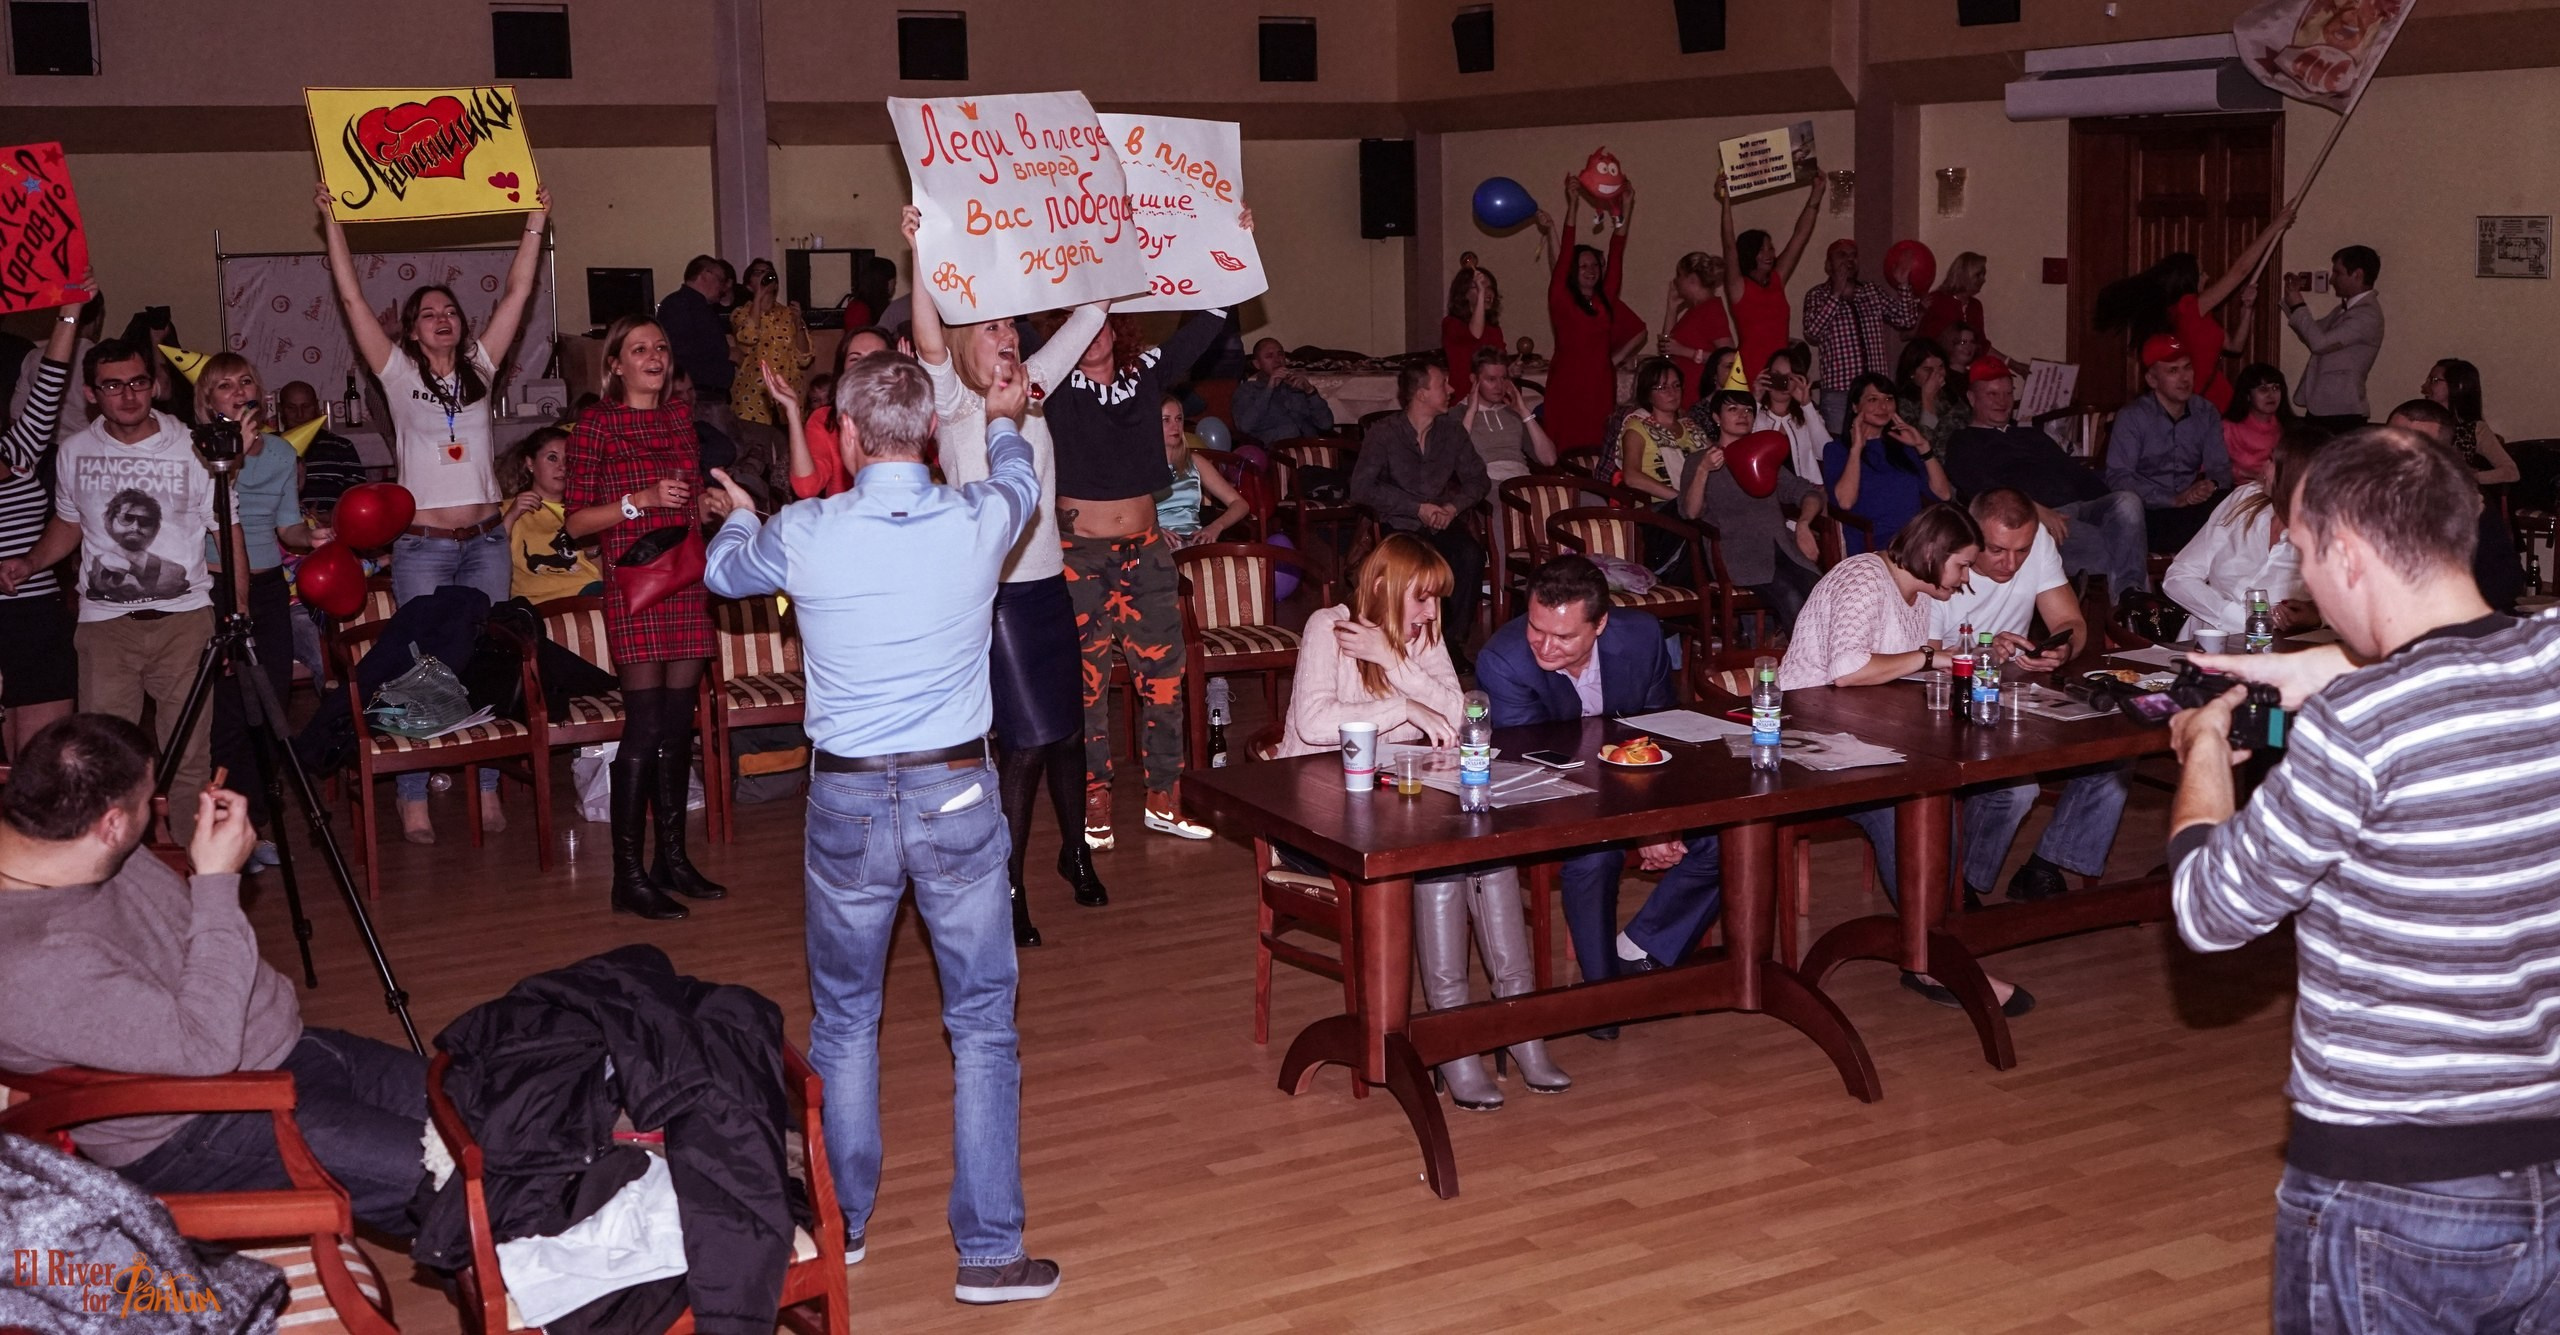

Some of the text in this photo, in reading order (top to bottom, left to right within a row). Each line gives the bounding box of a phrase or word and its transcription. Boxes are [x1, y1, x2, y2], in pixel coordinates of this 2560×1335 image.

[920, 103, 1014, 184] Леди
[1042, 125, 1111, 161] пледе
[1125, 126, 1233, 204] в пледе
[1012, 155, 1080, 187] вперед
[966, 171, 1132, 244] Вас победа
[1019, 239, 1103, 284] ждет
[80, 458, 184, 478] HANGOVER
[80, 475, 185, 495] THE MOVIE
